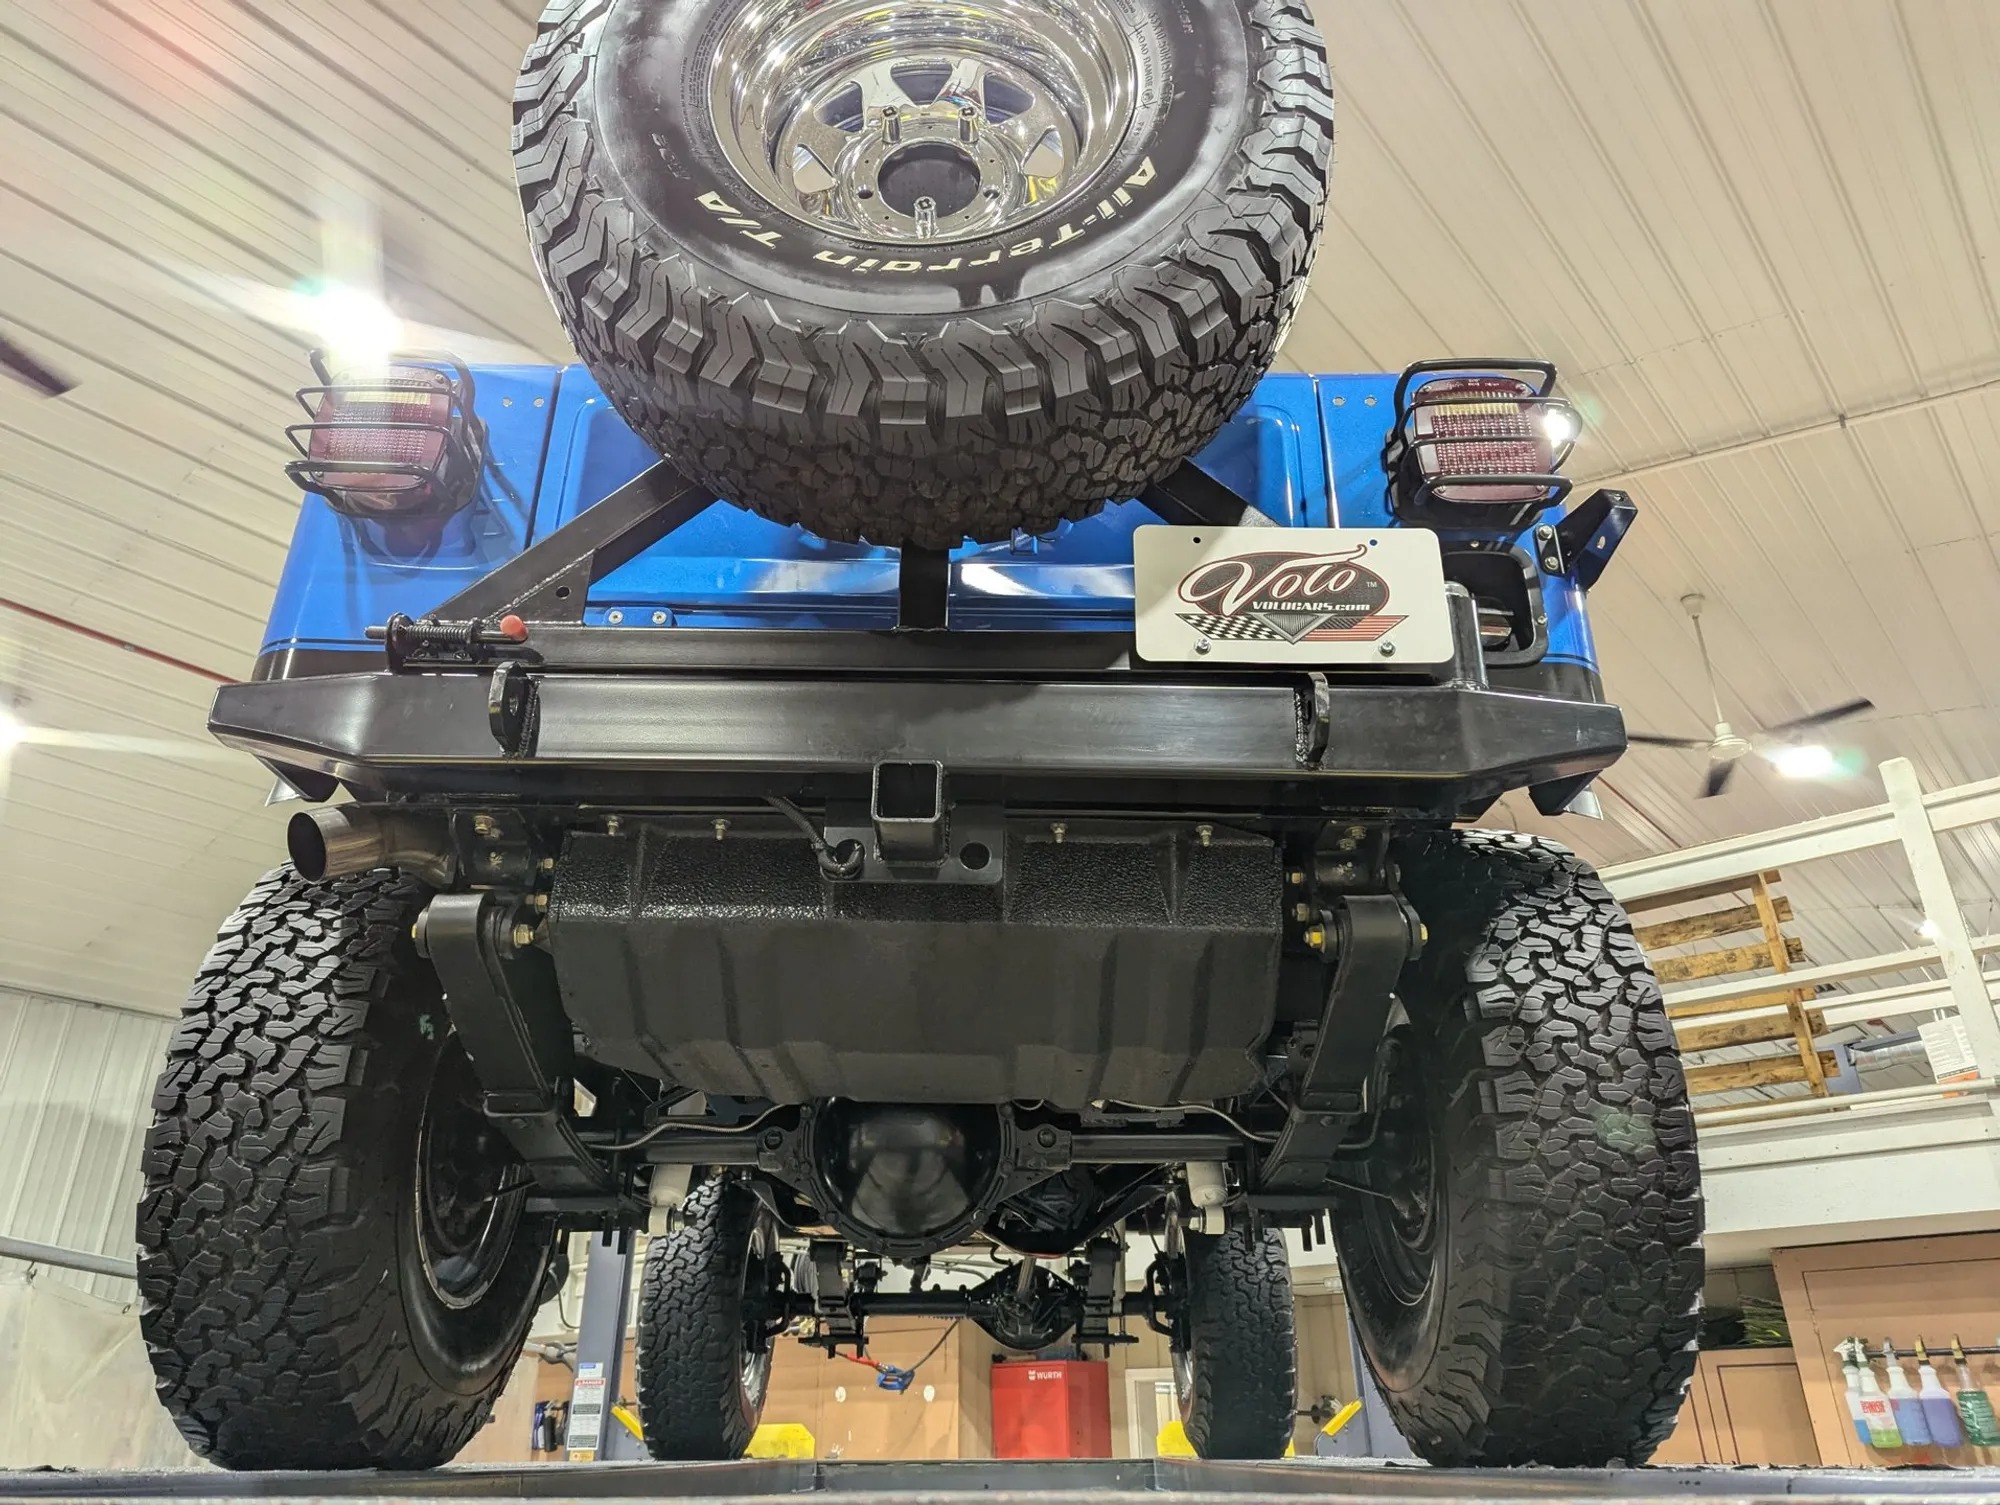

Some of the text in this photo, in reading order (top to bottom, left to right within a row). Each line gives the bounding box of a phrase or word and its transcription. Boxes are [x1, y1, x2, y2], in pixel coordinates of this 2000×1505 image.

[694, 190, 784, 250] T/A
[1179, 544, 1367, 617] Volo
[1252, 601, 1371, 611] VOLOCARS.com
